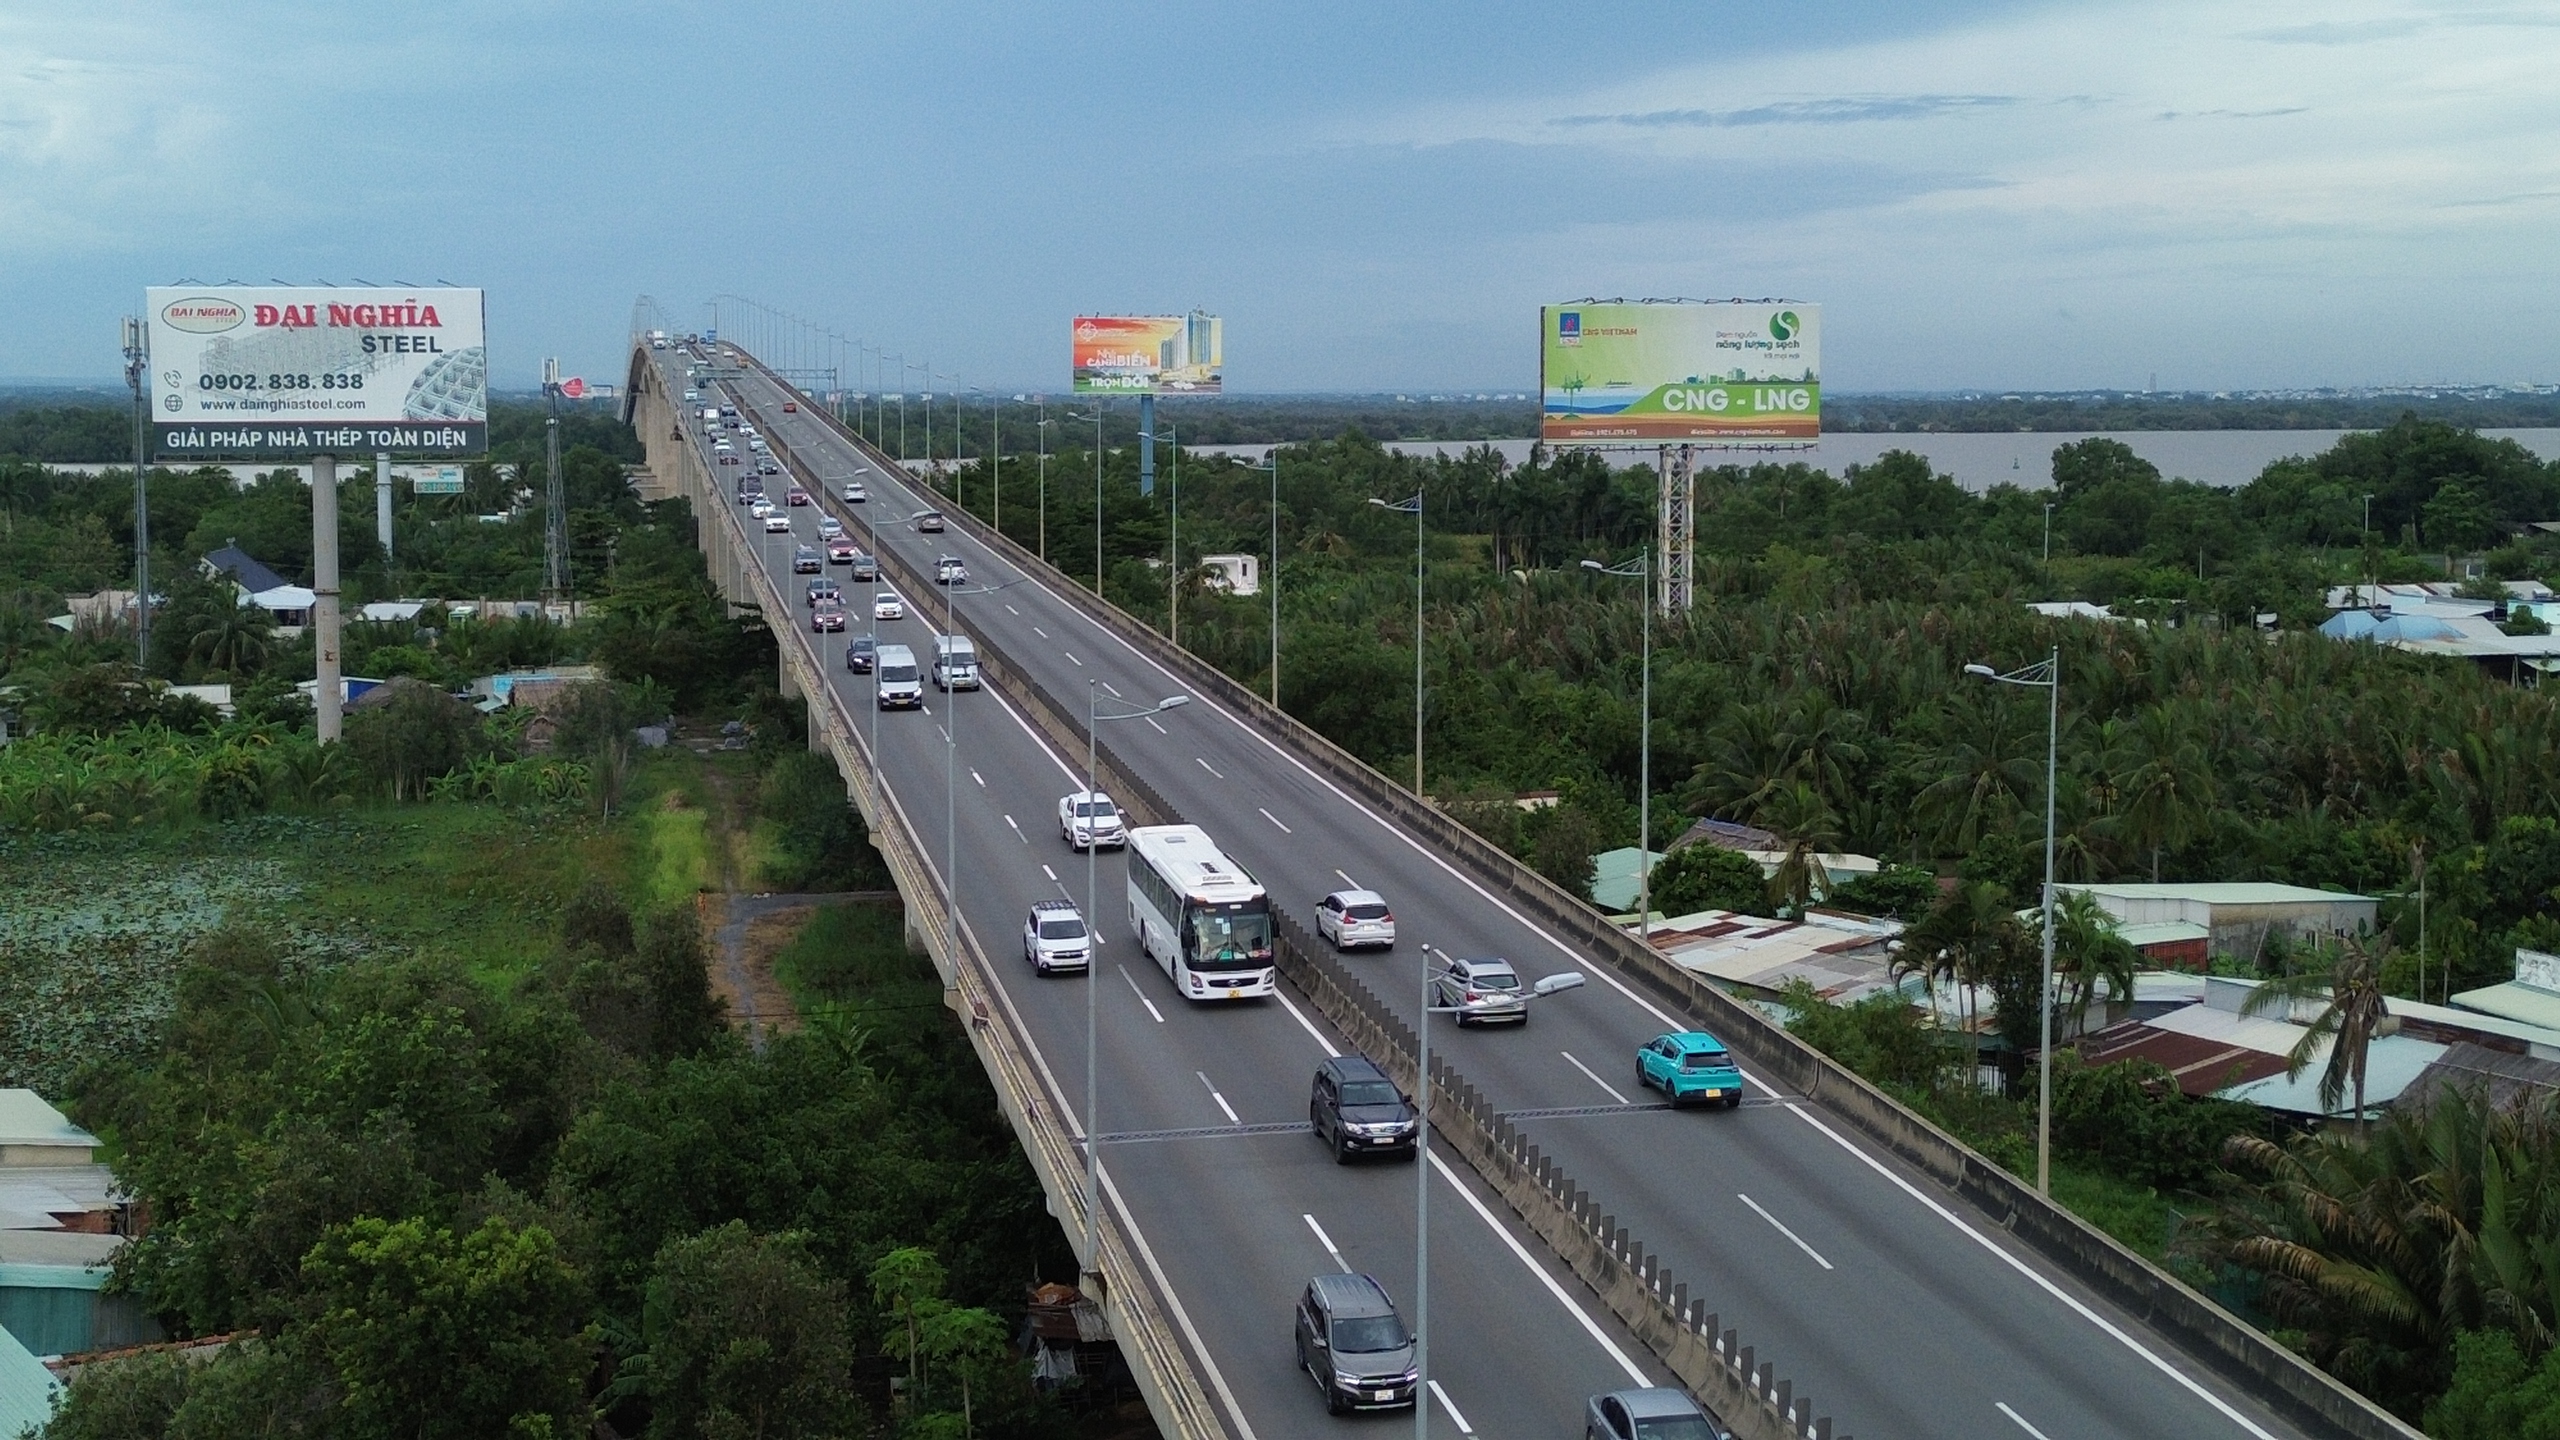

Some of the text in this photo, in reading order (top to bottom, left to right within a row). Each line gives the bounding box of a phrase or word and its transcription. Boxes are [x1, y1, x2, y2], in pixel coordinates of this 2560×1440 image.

[254, 299, 443, 332] ĐẠI NGHĨA
[361, 335, 443, 354] STEEL
[201, 397, 366, 412] www.dainghiasteel.com
[1662, 388, 1729, 411] CNG
[1754, 388, 1811, 411] LNG
[167, 427, 467, 449] GIẢI PHÁP NHÀ THÉP TOÀN DIỆN
